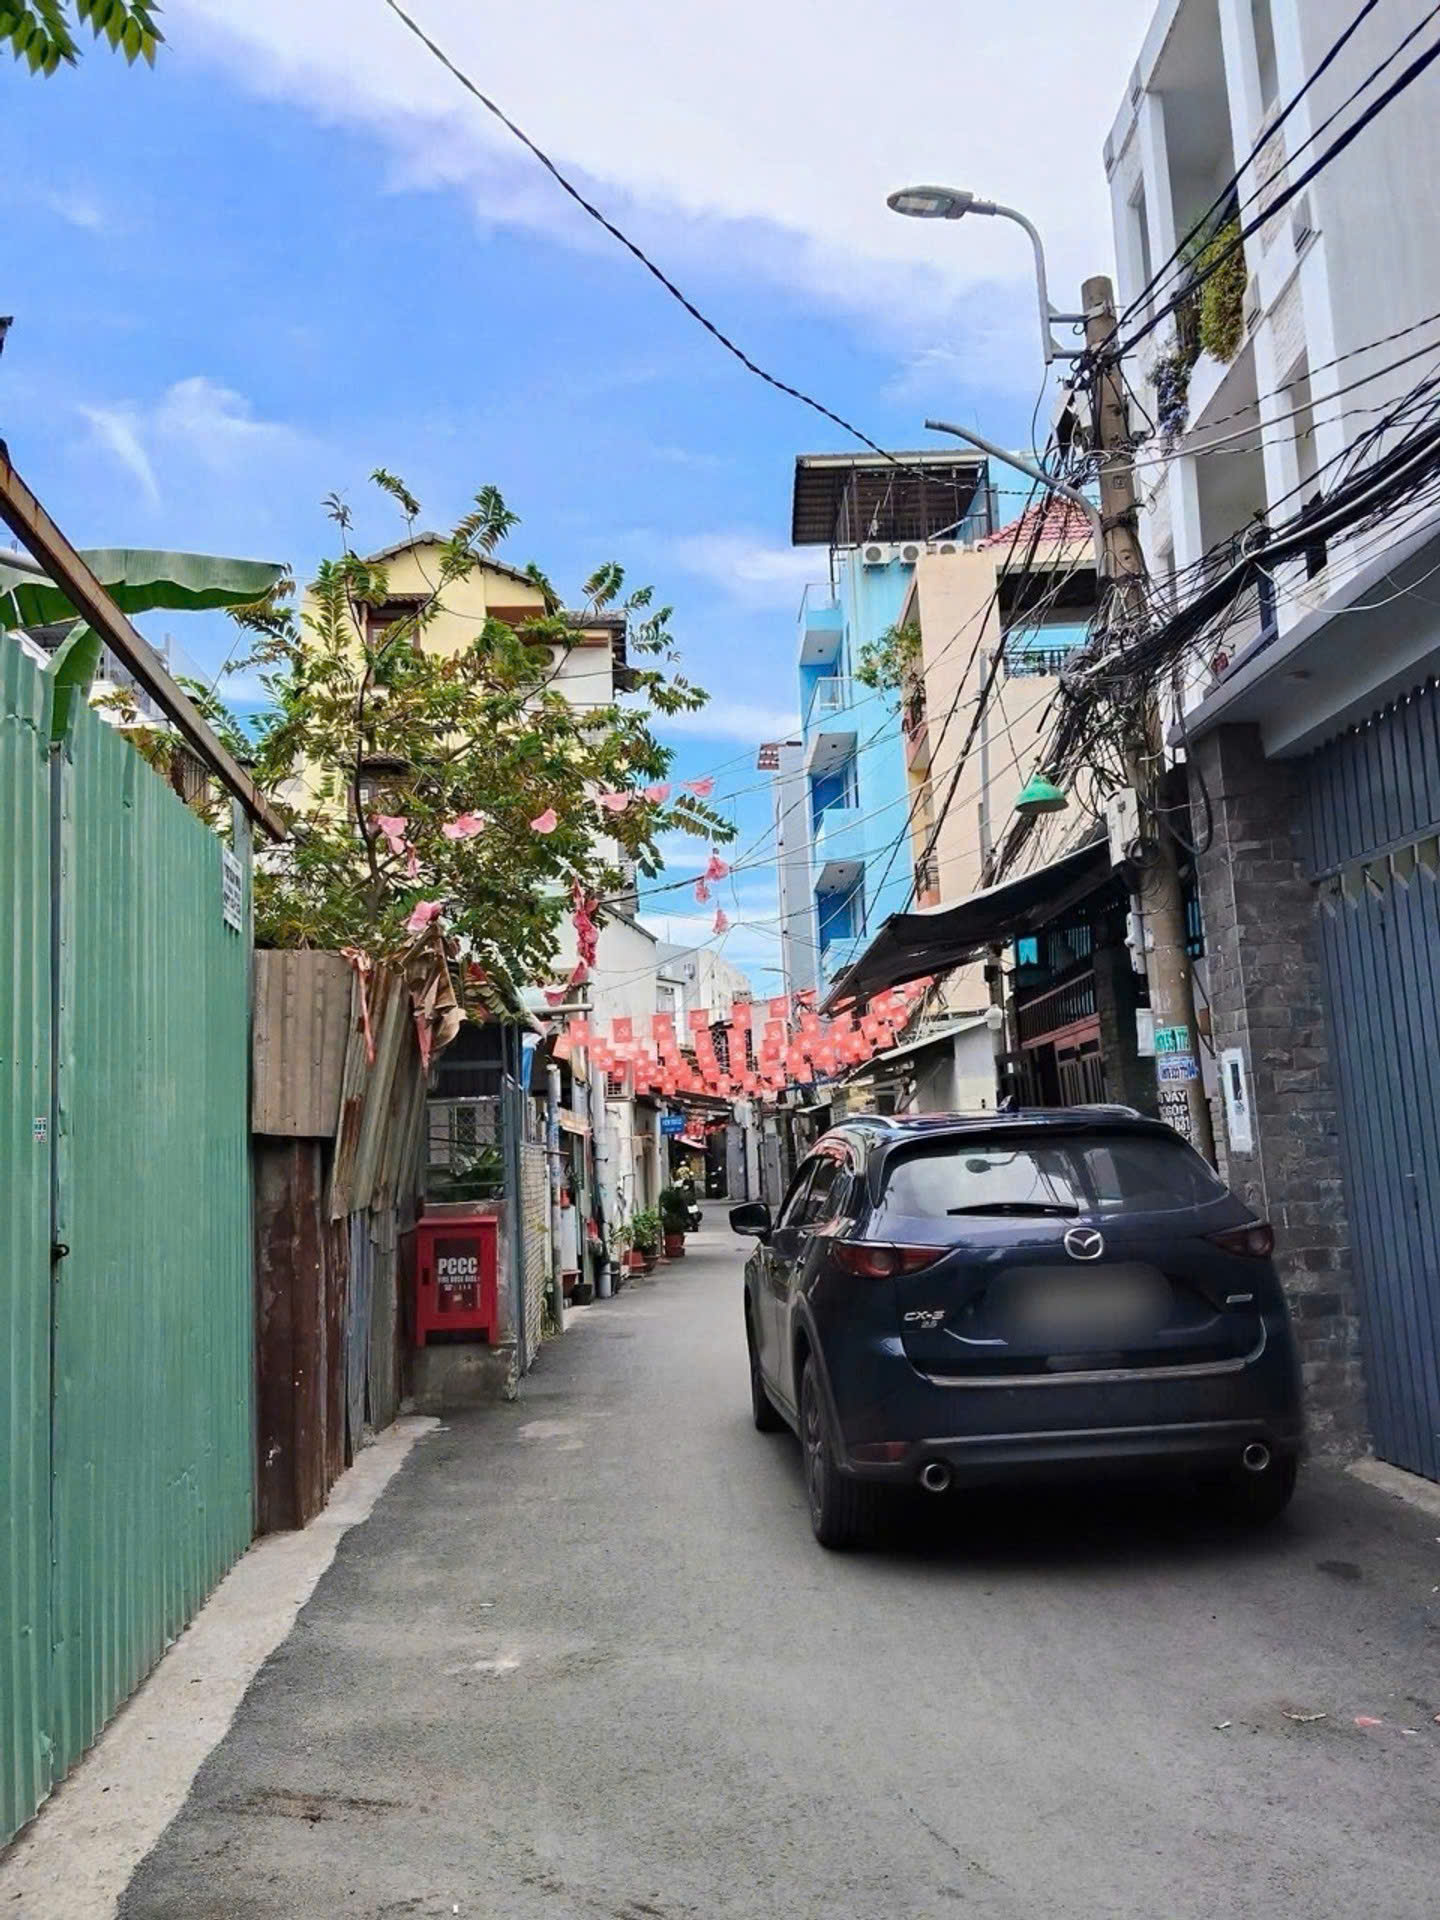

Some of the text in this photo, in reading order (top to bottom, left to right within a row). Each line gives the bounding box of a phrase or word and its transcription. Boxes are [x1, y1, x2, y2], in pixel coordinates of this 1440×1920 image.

[1164, 1090, 1186, 1102] VAY
[438, 1257, 478, 1275] PCCC
[903, 1310, 945, 1321] CX-5
